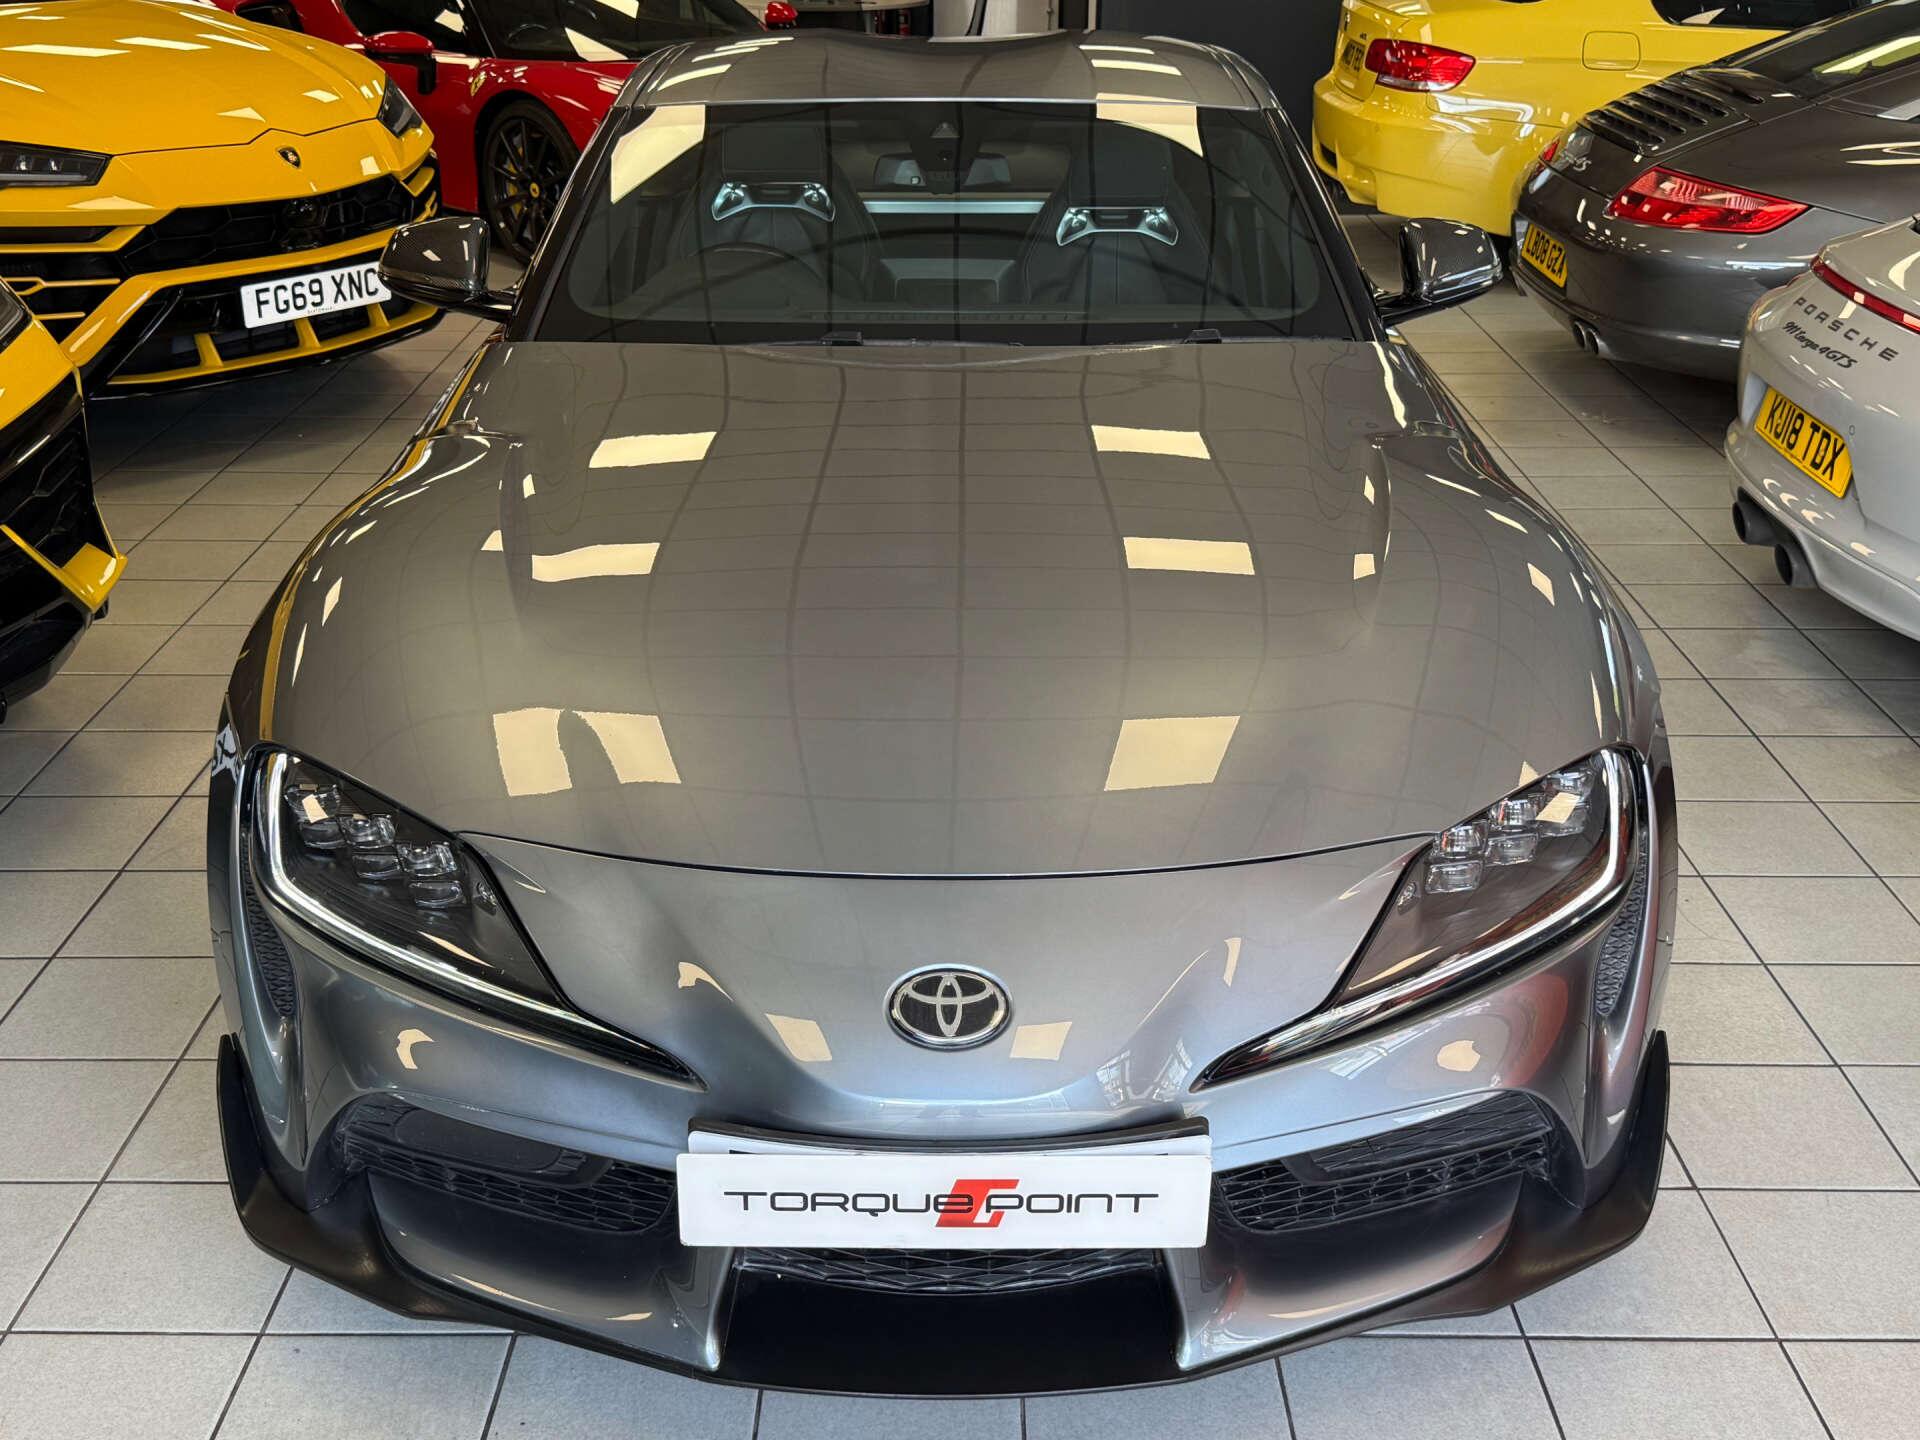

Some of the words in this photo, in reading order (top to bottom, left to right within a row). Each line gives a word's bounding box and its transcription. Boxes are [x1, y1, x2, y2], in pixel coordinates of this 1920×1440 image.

[255, 278, 324, 319] FG69
[331, 267, 379, 304] XNC
[1793, 296, 1899, 362] PORSCHE
[1763, 394, 1805, 451] KJ18
[1802, 421, 1846, 481] TDX
